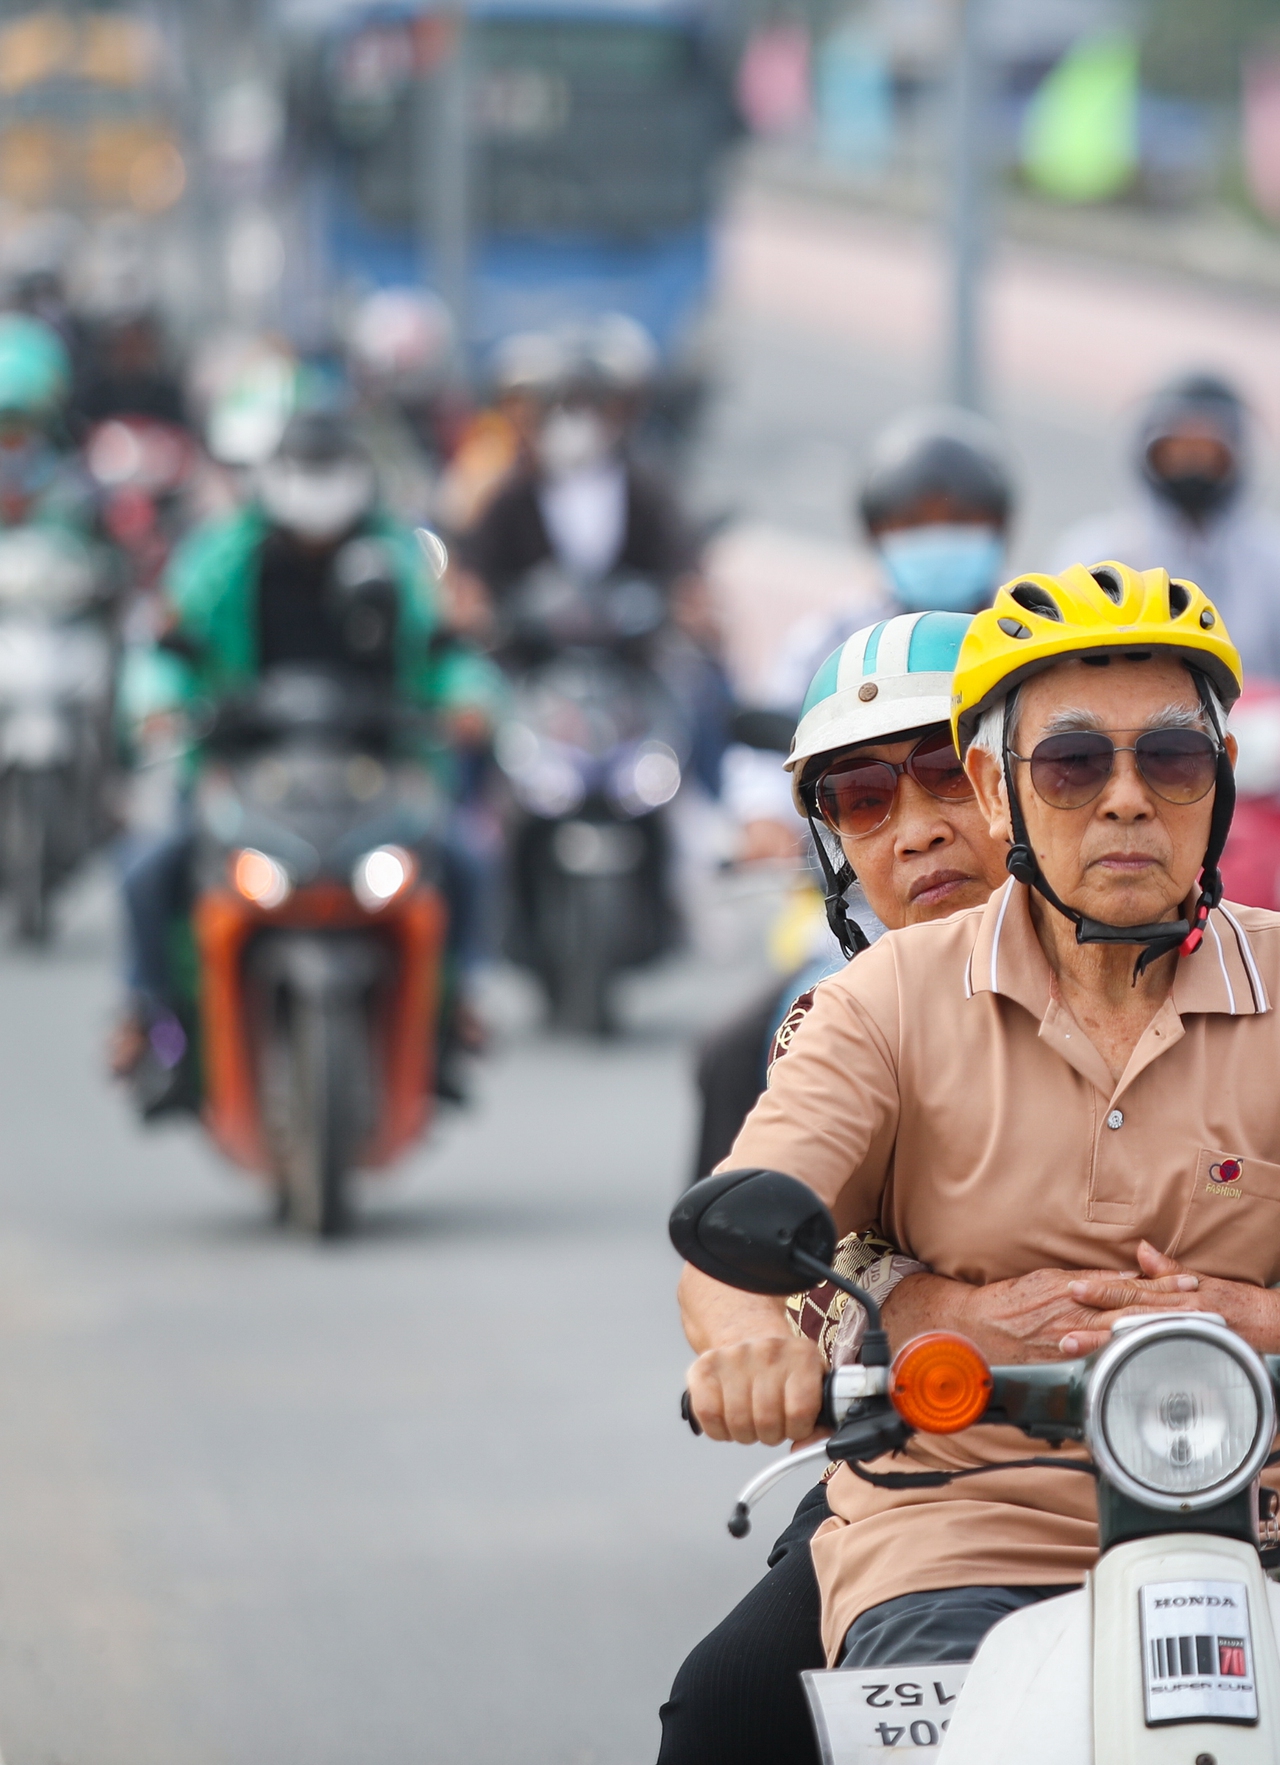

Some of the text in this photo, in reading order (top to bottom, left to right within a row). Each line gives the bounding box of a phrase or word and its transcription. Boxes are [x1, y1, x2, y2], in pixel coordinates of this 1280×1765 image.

[1205, 1183, 1243, 1199] FASHION
[1154, 1595, 1239, 1609] HONDA
[1220, 1646, 1247, 1676] 70
[861, 1680, 966, 1708] 152
[874, 1719, 951, 1747] 04
